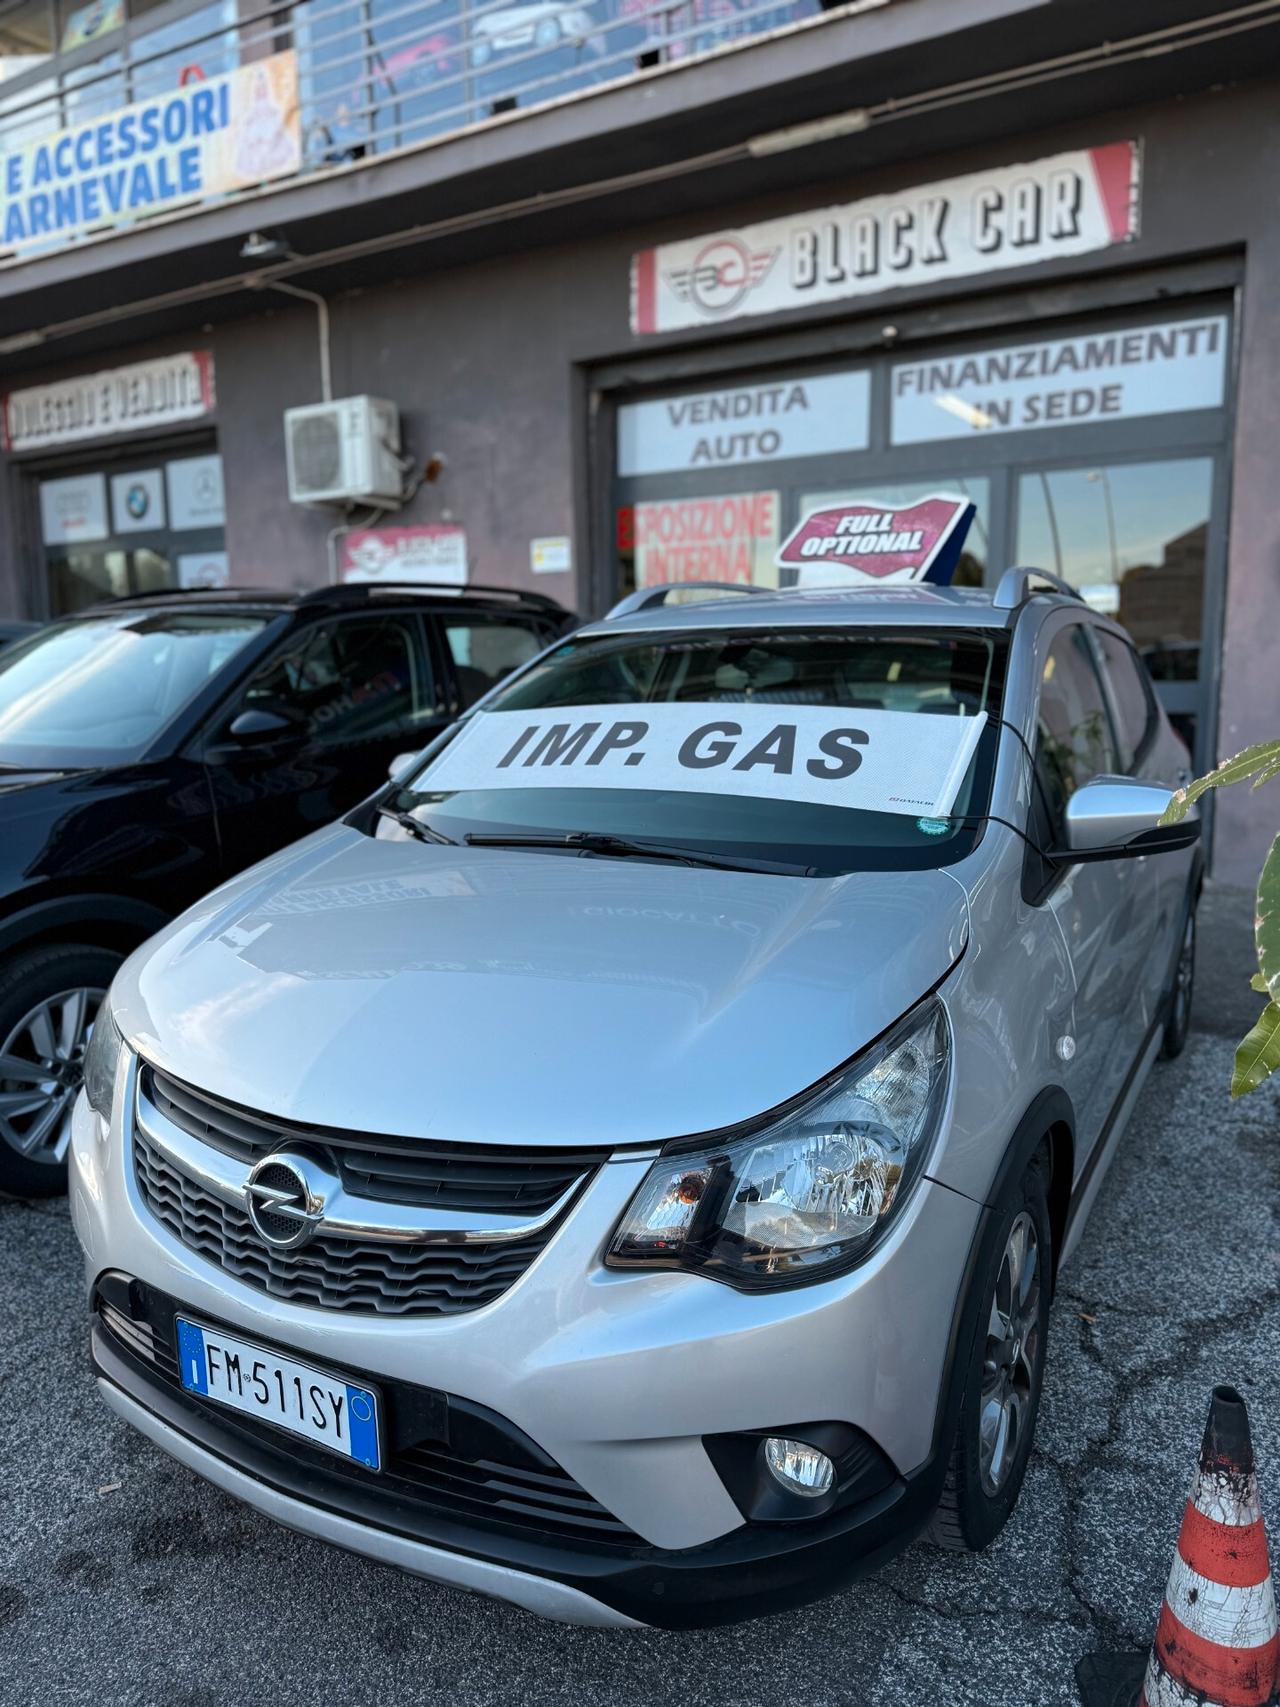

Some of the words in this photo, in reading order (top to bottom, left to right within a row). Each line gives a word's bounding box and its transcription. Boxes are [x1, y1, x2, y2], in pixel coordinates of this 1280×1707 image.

[6, 154, 22, 195] E
[32, 83, 230, 187] ACCESSORI
[0, 146, 203, 243] ARNEVALE
[792, 199, 948, 290] BLACK
[971, 169, 1081, 253] CAR
[897, 324, 1220, 397] FINANZIAMENTI
[667, 385, 809, 427] VENDITA
[1023, 385, 1123, 424] SEDE
[690, 429, 781, 463] AUTO
[801, 531, 923, 556] OPTIONAL
[836, 513, 894, 534] FULL
[646, 543, 752, 587] INTERNA
[496, 721, 649, 768] IMP.
[678, 721, 870, 780] GAS
